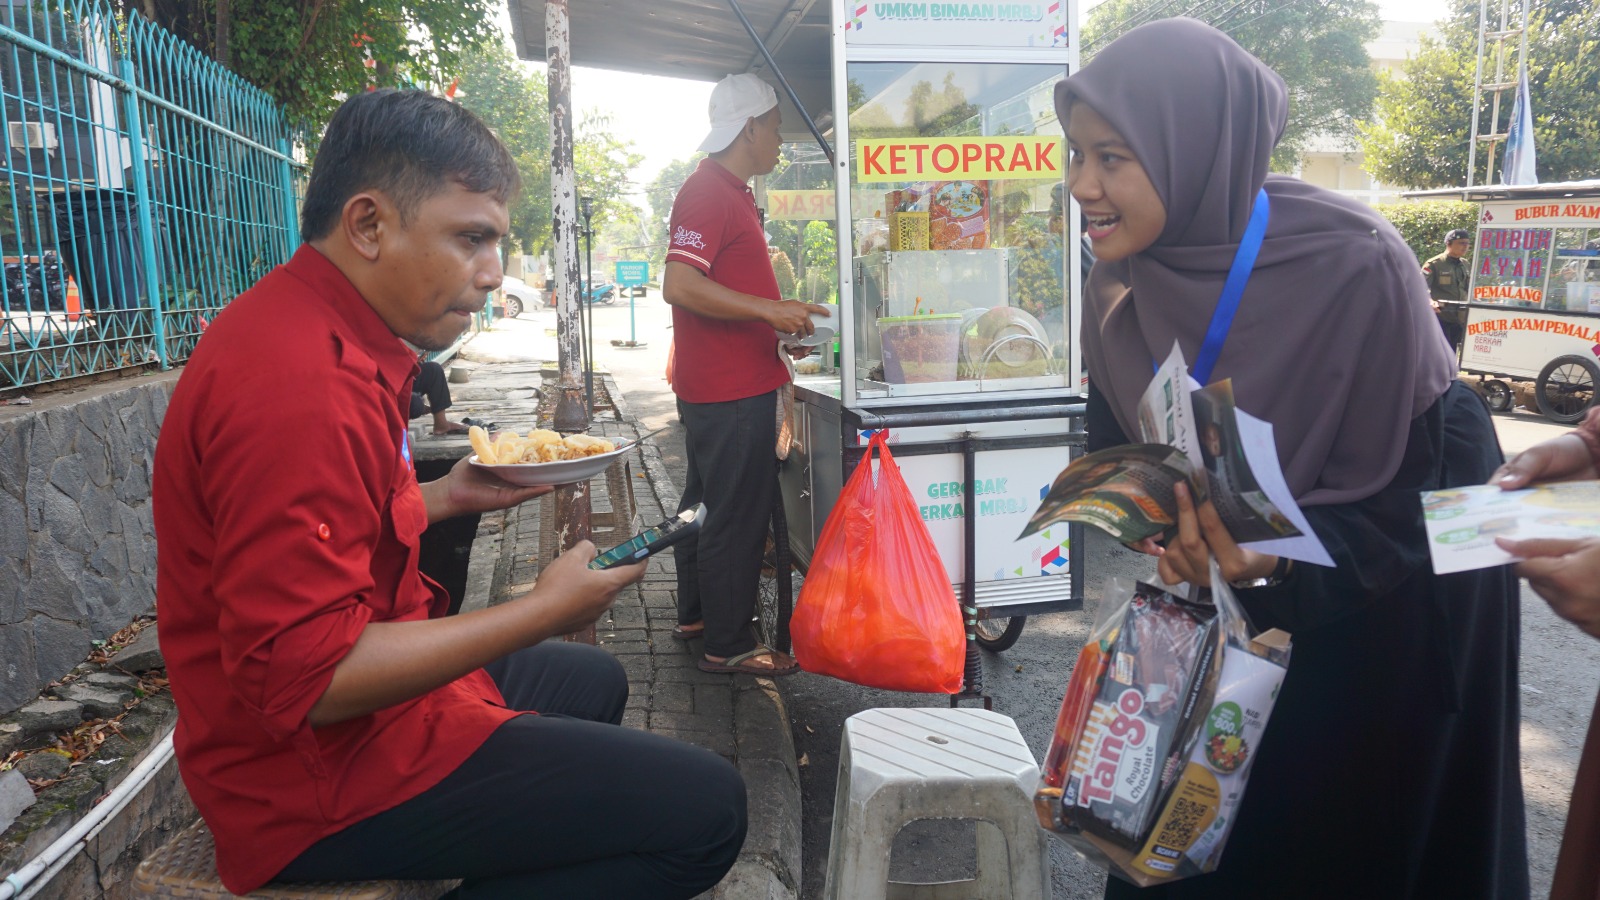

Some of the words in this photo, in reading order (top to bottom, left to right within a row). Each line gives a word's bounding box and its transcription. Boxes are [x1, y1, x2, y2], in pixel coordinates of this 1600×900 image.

[874, 2, 927, 20] UMKM
[930, 3, 996, 20] BINAAN
[996, 4, 1043, 21] MRBJ
[863, 142, 1057, 175] KETOPRAK
[1515, 204, 1559, 220] BUBUR
[1561, 204, 1600, 219] AYAM
[674, 226, 702, 241] SILVER
[674, 236, 706, 250] LEGACY
[1480, 229, 1552, 251] BUBUR
[1480, 257, 1542, 278] AYAM
[1473, 286, 1542, 303] PEMALANG
[1467, 319, 1508, 336] BUBUR
[1510, 318, 1544, 332] AYAM
[1473, 344, 1492, 353] MRBJ
[1474, 336, 1502, 346] BERKAH
[919, 503, 965, 521] ERKA
[980, 498, 1028, 515] MRBJ
[1080, 691, 1146, 804] Tango
[1126, 756, 1142, 785] Royal
[1130, 745, 1155, 800] Chocolate
